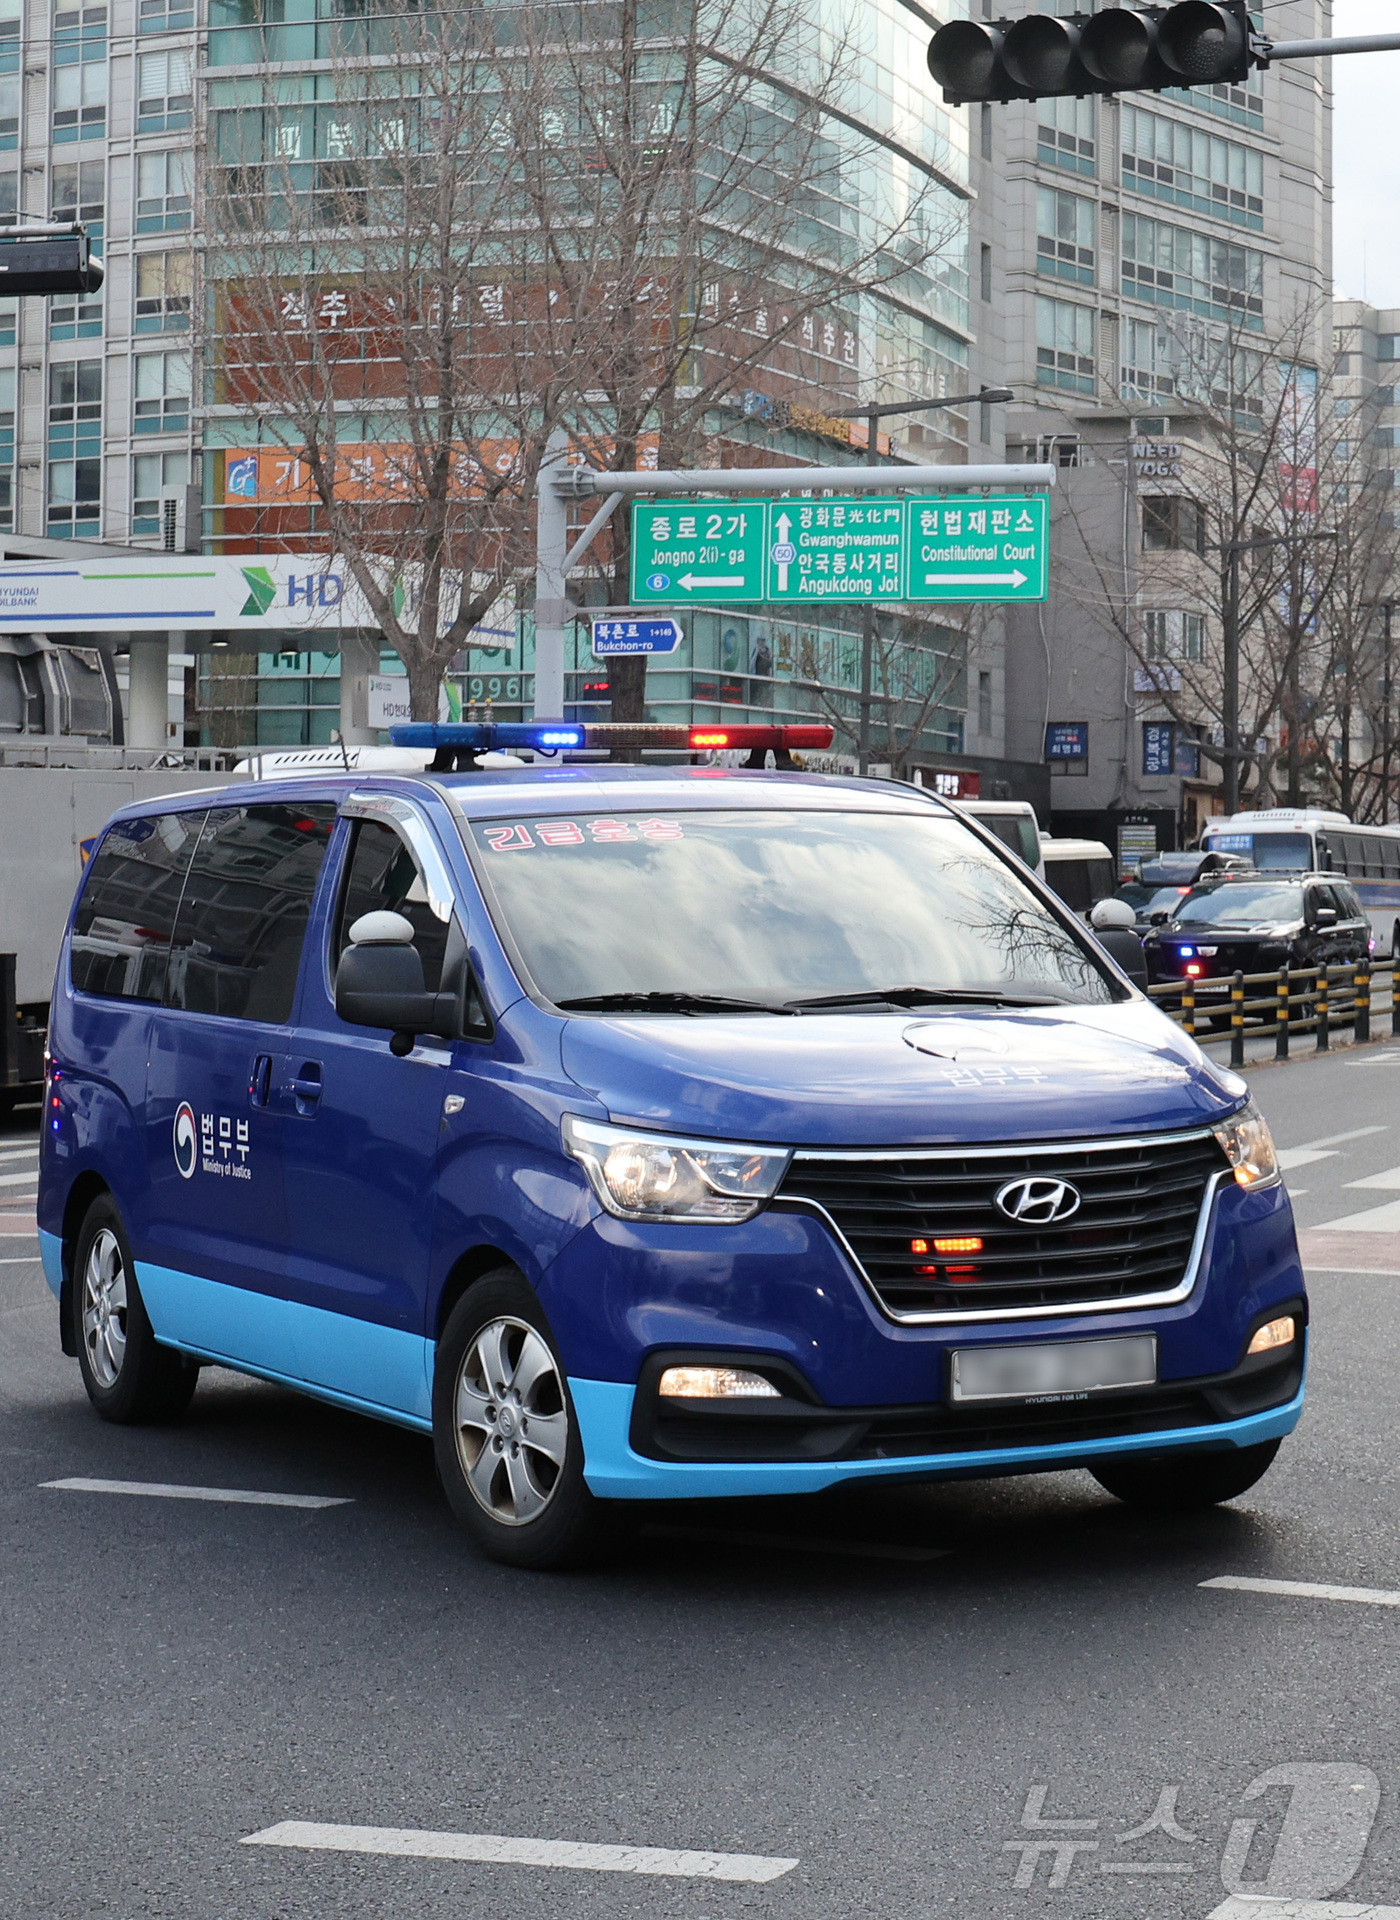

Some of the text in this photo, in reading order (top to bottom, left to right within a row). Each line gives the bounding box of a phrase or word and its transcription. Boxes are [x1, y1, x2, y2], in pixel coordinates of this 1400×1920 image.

[1132, 443, 1181, 458] NEED
[1135, 460, 1181, 477] YOGA
[650, 513, 748, 541] 종로2가
[919, 508, 1035, 536] 헌법재판소
[799, 531, 900, 549] Gwanghwamun
[650, 550, 696, 567] Jongno
[777, 549, 791, 559] 50
[920, 542, 1036, 562] Constitutional Court
[798, 551, 899, 575] 안국동사거리
[288, 574, 342, 608] HD
[653, 576, 663, 588] 6
[798, 576, 873, 596] Angukdong
[597, 624, 639, 640] 북촌로
[597, 641, 653, 651] Bukchon-ro
[483, 818, 684, 851] 긴급호송
[940, 1065, 1049, 1087] 법무부
[201, 1113, 250, 1162] 법무부
[202, 1157, 251, 1180] Ministry of Justice
